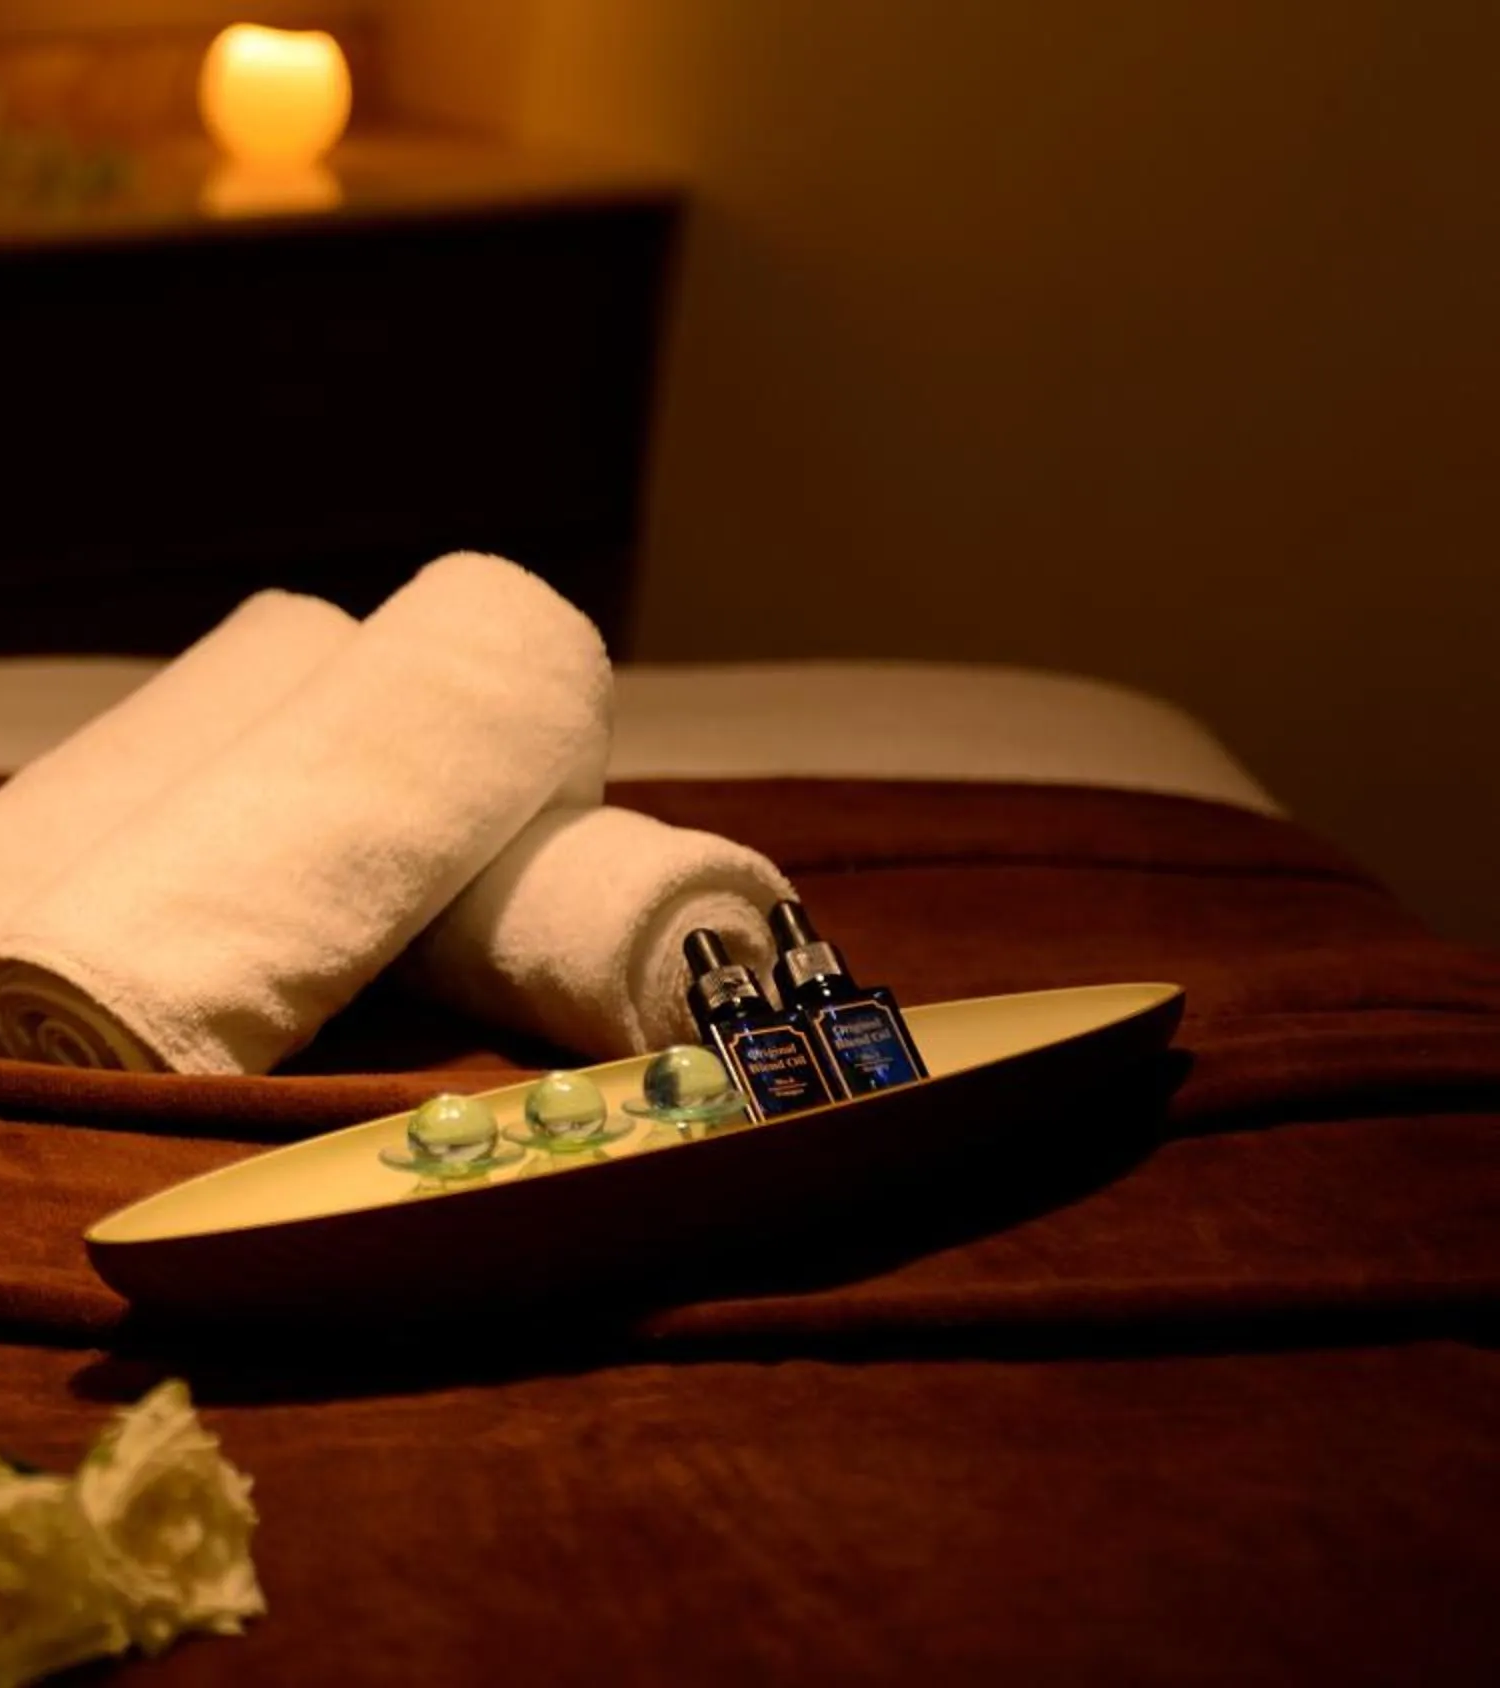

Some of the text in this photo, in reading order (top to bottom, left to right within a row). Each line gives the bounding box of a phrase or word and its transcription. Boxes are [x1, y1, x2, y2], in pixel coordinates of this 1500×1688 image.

[832, 1017, 882, 1035] Original
[871, 1028, 891, 1042] Oil
[747, 1043, 797, 1060] Original
[786, 1055, 807, 1067] Oil
